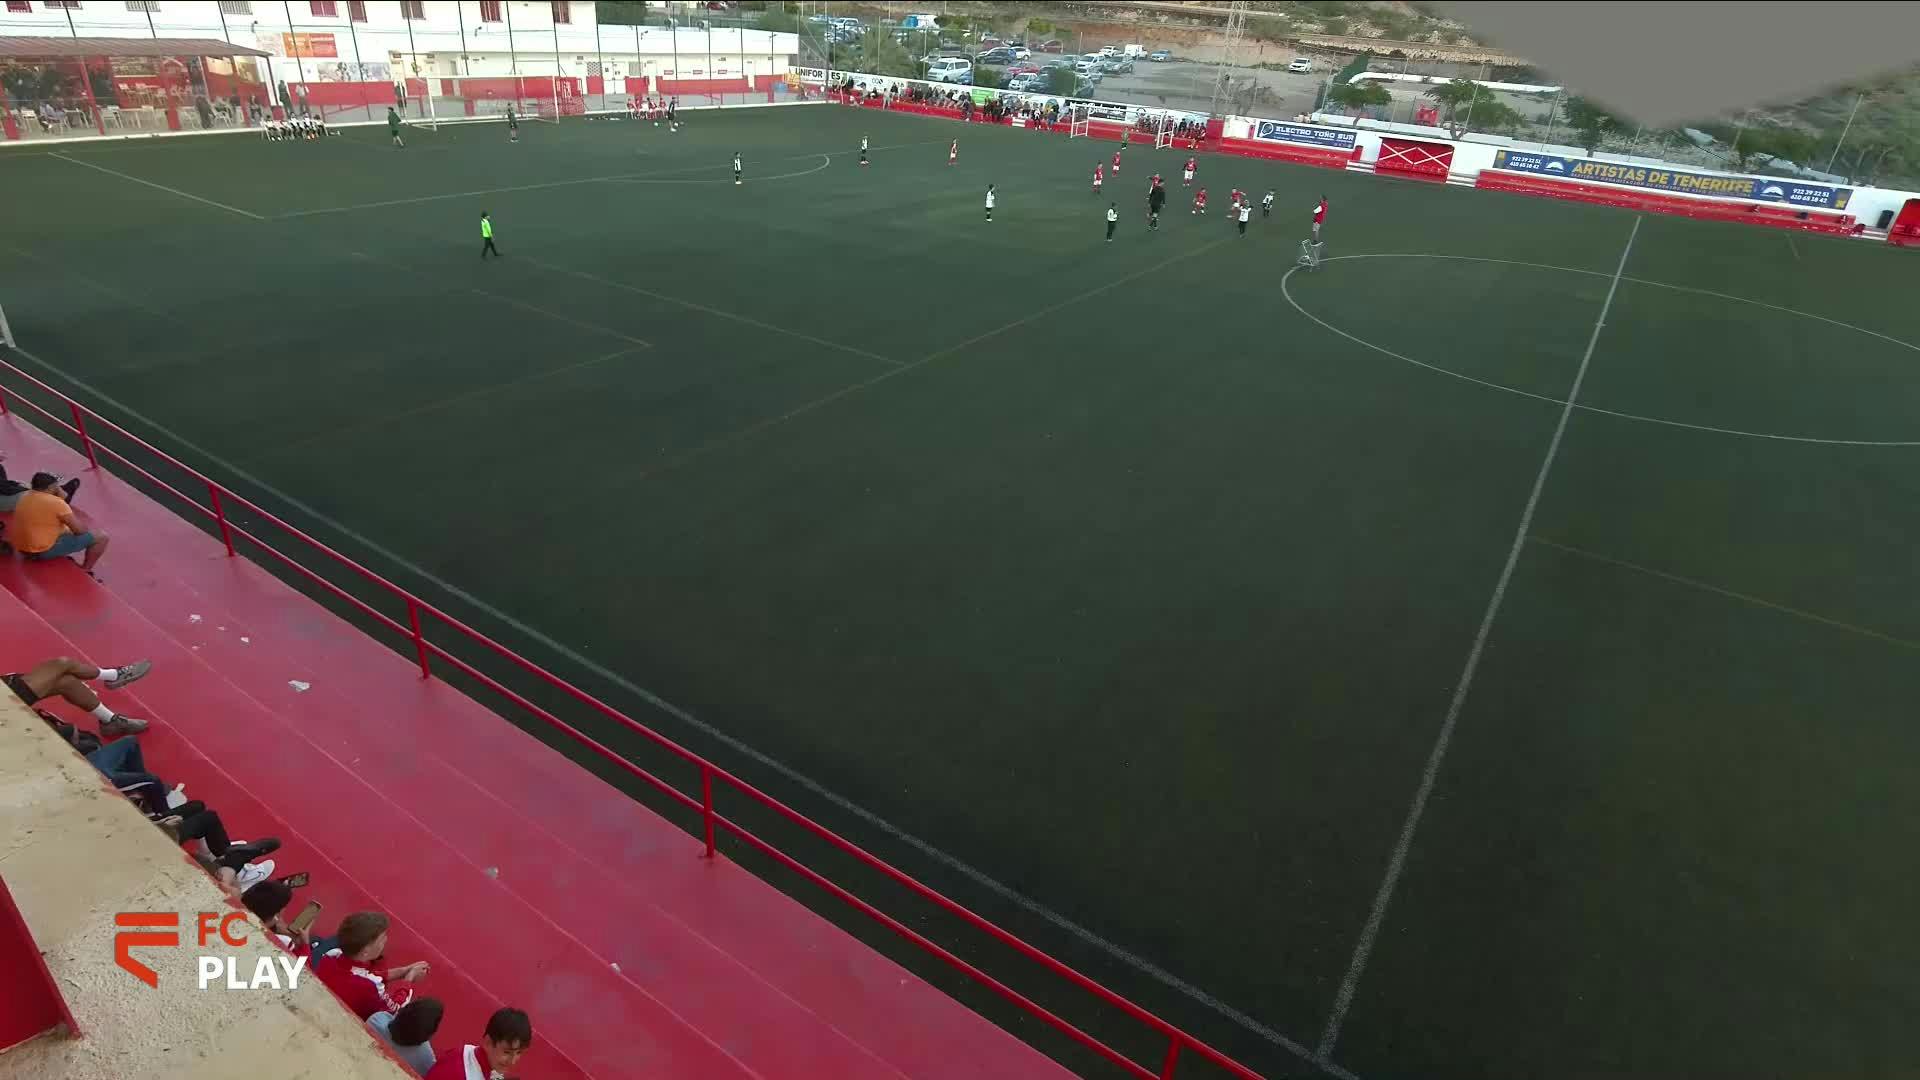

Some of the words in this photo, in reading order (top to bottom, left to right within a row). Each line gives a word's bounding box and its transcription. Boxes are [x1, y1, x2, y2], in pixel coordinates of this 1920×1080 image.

[795, 67, 841, 80] UNIFORES
[1275, 125, 1312, 136] ELECTRO
[1313, 130, 1336, 139] TOÑO
[1337, 133, 1355, 141] SUR
[1571, 162, 1646, 181] ARTISTAS
[1648, 170, 1670, 185] DE
[1672, 173, 1755, 193] TENERIFE
